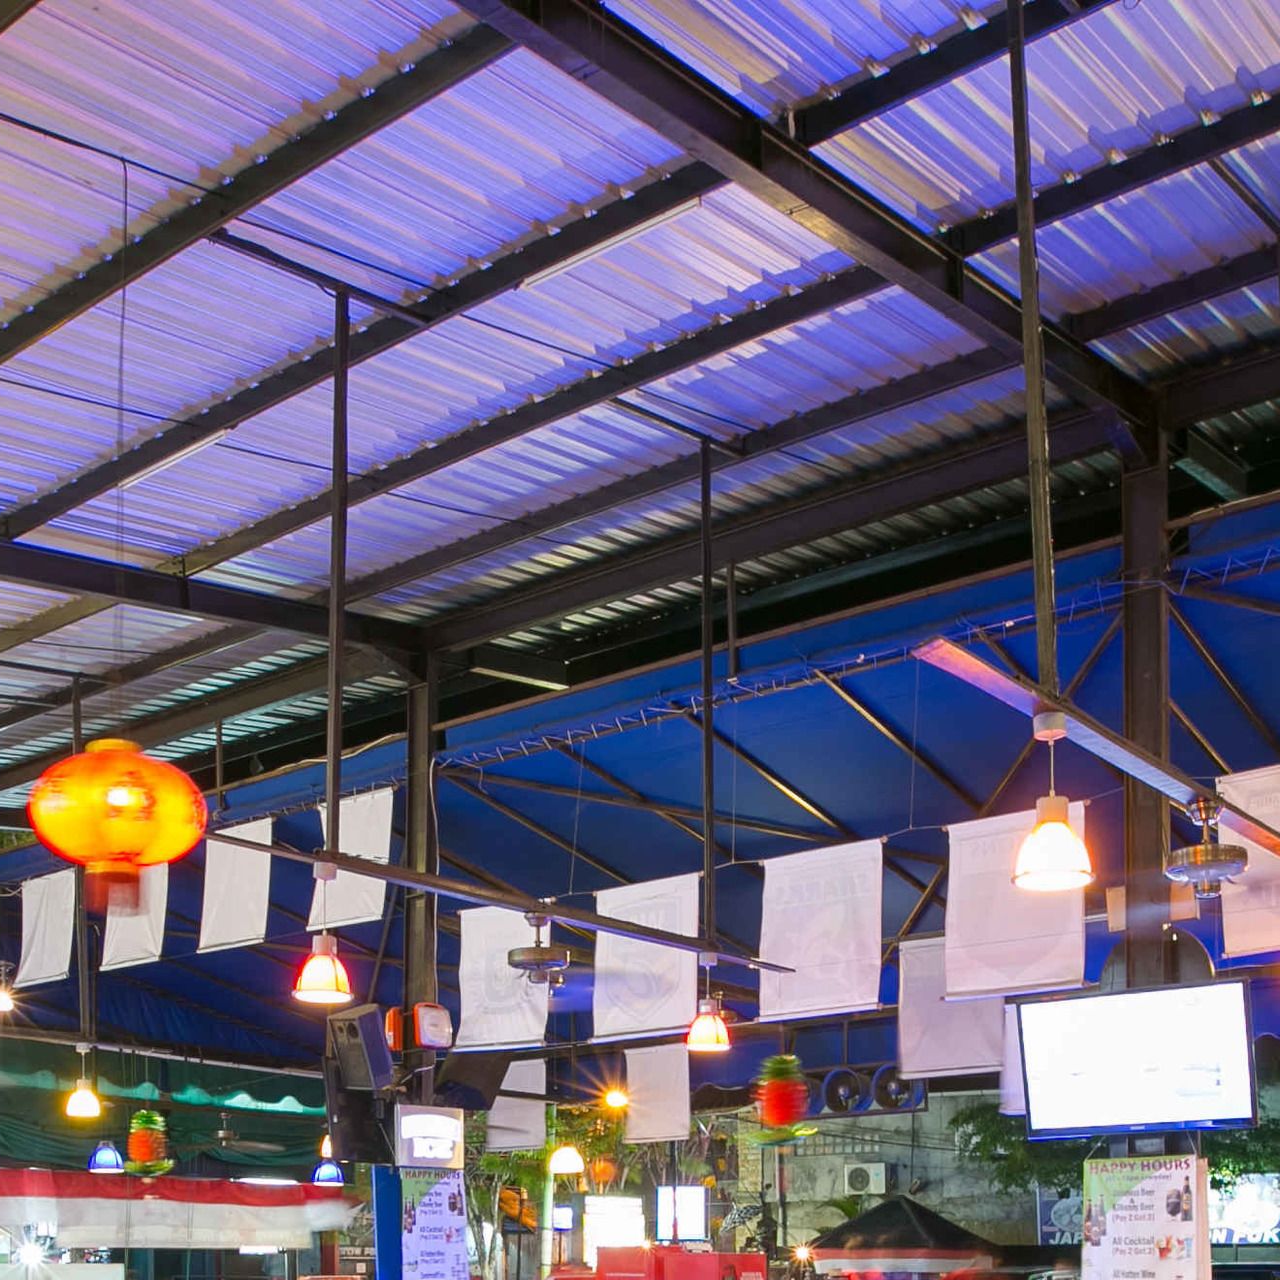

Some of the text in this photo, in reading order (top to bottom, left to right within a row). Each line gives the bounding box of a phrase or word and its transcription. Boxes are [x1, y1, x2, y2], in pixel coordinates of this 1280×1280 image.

[1089, 1159, 1191, 1175] HAPPY HOURS
[405, 1170, 460, 1179] HAPPY HOURS
[1049, 1231, 1083, 1245] JAP
